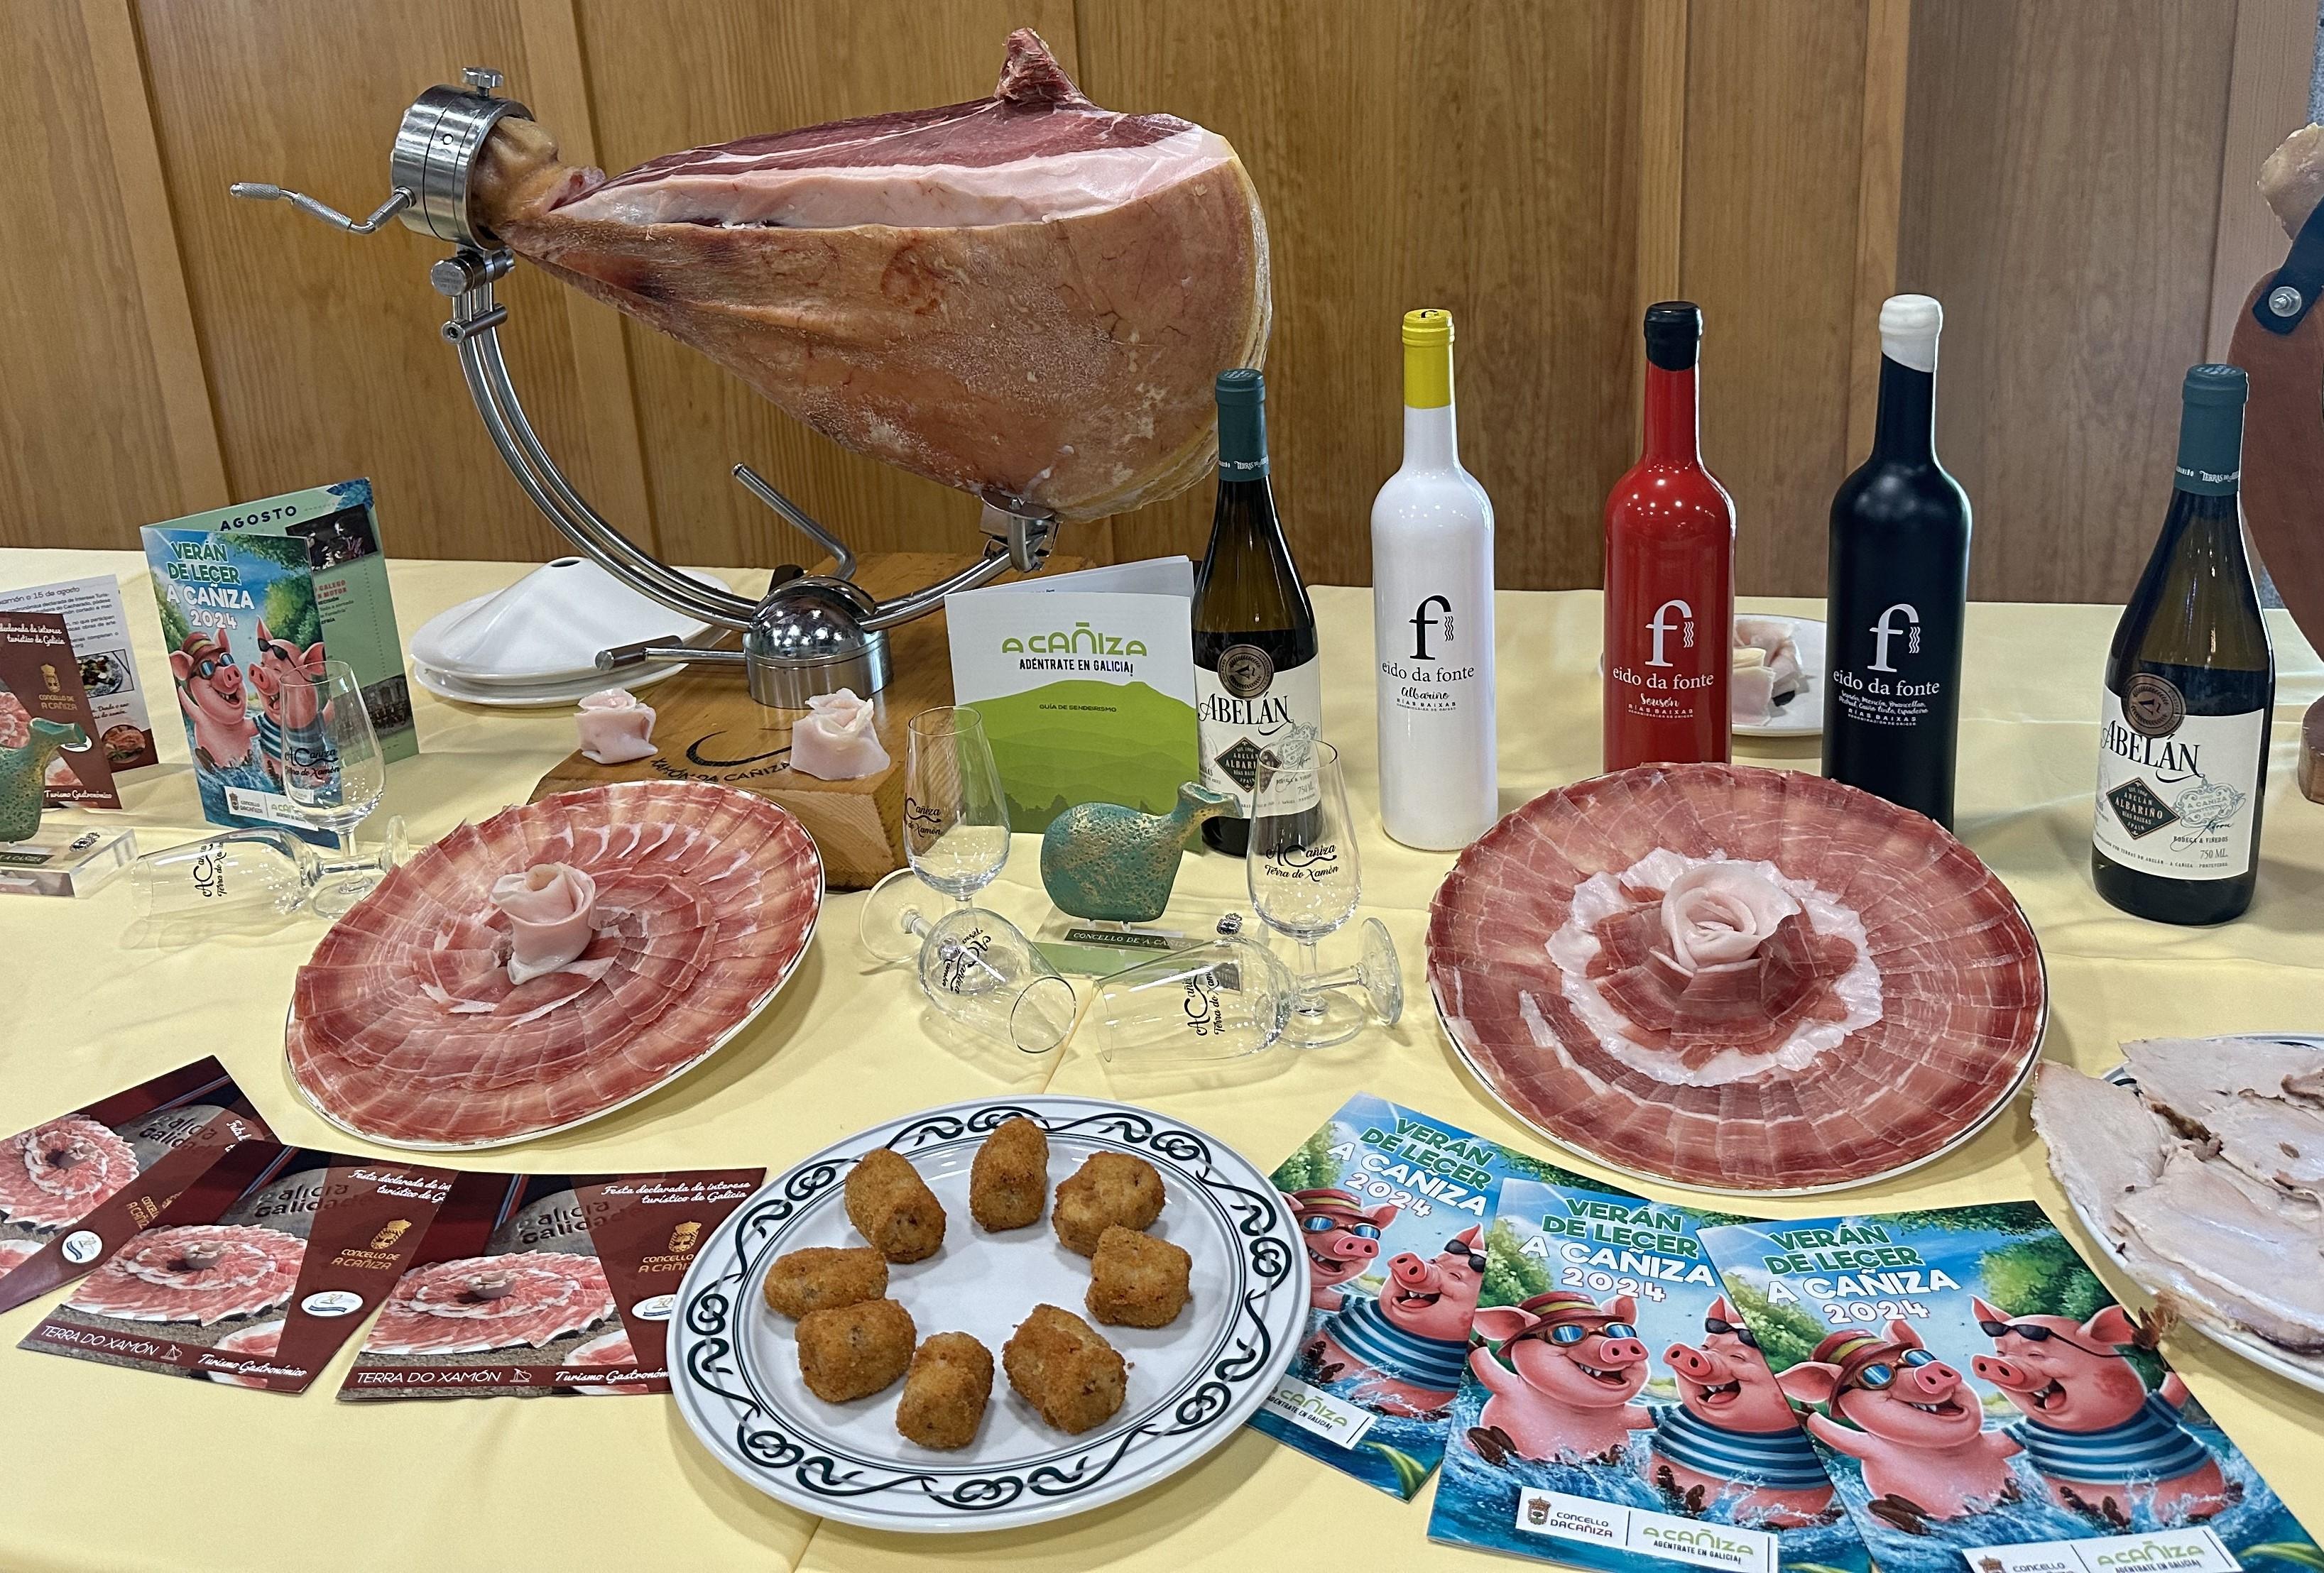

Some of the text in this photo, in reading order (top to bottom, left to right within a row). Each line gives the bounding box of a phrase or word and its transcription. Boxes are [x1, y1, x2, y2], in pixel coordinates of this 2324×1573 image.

[2199, 471, 2223, 483] TERRAS
[220, 505, 297, 531] AGOSTO
[171, 539, 229, 562] VERÁN
[167, 562, 190, 581] DE
[56, 586, 80, 597] agosto
[166, 583, 256, 610] A CAÑIZA
[189, 609, 238, 630] 2024
[1409, 595, 1452, 661] f
[1001, 621, 1147, 657] A CAÑIZA
[1644, 599, 1693, 667] f
[1867, 603, 1919, 673] f
[1019, 657, 1134, 677] ADÉNTRATE EN GALICIA!
[1382, 661, 1475, 683] eido da fonte
[1613, 667, 1714, 690] eido da fonte
[1833, 669, 1941, 697] eido da fonte
[49, 701, 78, 711] CAÑIZA
[1198, 691, 1294, 736] ABELÁN
[294, 747, 339, 767] Cañiza
[2101, 719, 2206, 783] ABELÁN
[723, 762, 790, 782] CAÑIZA
[44, 789, 71, 799] Turismo
[2115, 796, 2164, 819] ALBARIÑO
[1265, 842, 1338, 868] A Cañiza
[2200, 849, 2213, 860] 750
[1264, 864, 1339, 882] Terra do Xamón
[1073, 932, 1124, 943] CONCELLO
[1186, 1015, 1211, 1036] A
[1209, 994, 1226, 1035] Terra do
[1396, 1117, 1495, 1168] VERÁN
[1360, 1127, 1492, 1191] DE LECER
[348, 1169, 378, 1183] Festa
[378, 1172, 424, 1189] declarada
[424, 1179, 438, 1190] de
[601, 1180, 751, 1196] Festa declarada de interese
[1326, 1141, 1488, 1217] A CAÑIZA
[376, 1184, 419, 1200] turístico
[419, 1189, 432, 1200] de
[641, 1191, 747, 1205] turístico de Galicia
[1344, 1172, 1432, 1217] 2024
[1564, 1197, 1683, 1234] VERÁN
[1542, 1214, 1699, 1259] DE LECER
[1768, 1223, 1892, 1251] VERÁN
[331, 1257, 393, 1271] A CAÑIZA
[341, 1249, 402, 1261] CONCELLO DE
[643, 1254, 694, 1264] CONCELLO
[1518, 1235, 1716, 1287] A CAÑIZA
[1762, 1246, 1926, 1276] DE LECER
[638, 1265, 650, 1273] A
[1561, 1267, 1666, 1303] 2024
[1766, 1268, 1963, 1304] A CAÑIZA
[1823, 1299, 1930, 1325] 2024
[41, 1325, 160, 1356] TERRA DO XAMÓN
[197, 1353, 307, 1378] Turismo Gastronómico
[357, 1369, 503, 1383] TERRA DO XAMÓN
[555, 1370, 604, 1383] Turismo
[1280, 1389, 1348, 1427] CAÑIZA
[1556, 1511, 1609, 1527] CONCELLO
[1642, 1527, 1754, 1557] A CAÑIZA
[2097, 1540, 2205, 1567] A CAÑIZA
[1697, 1548, 1708, 1557] EN
[1709, 1550, 1742, 1564] GALICIA!
[2012, 1562, 2066, 1573] CONCELLO
[2158, 1562, 2168, 1571] EN
